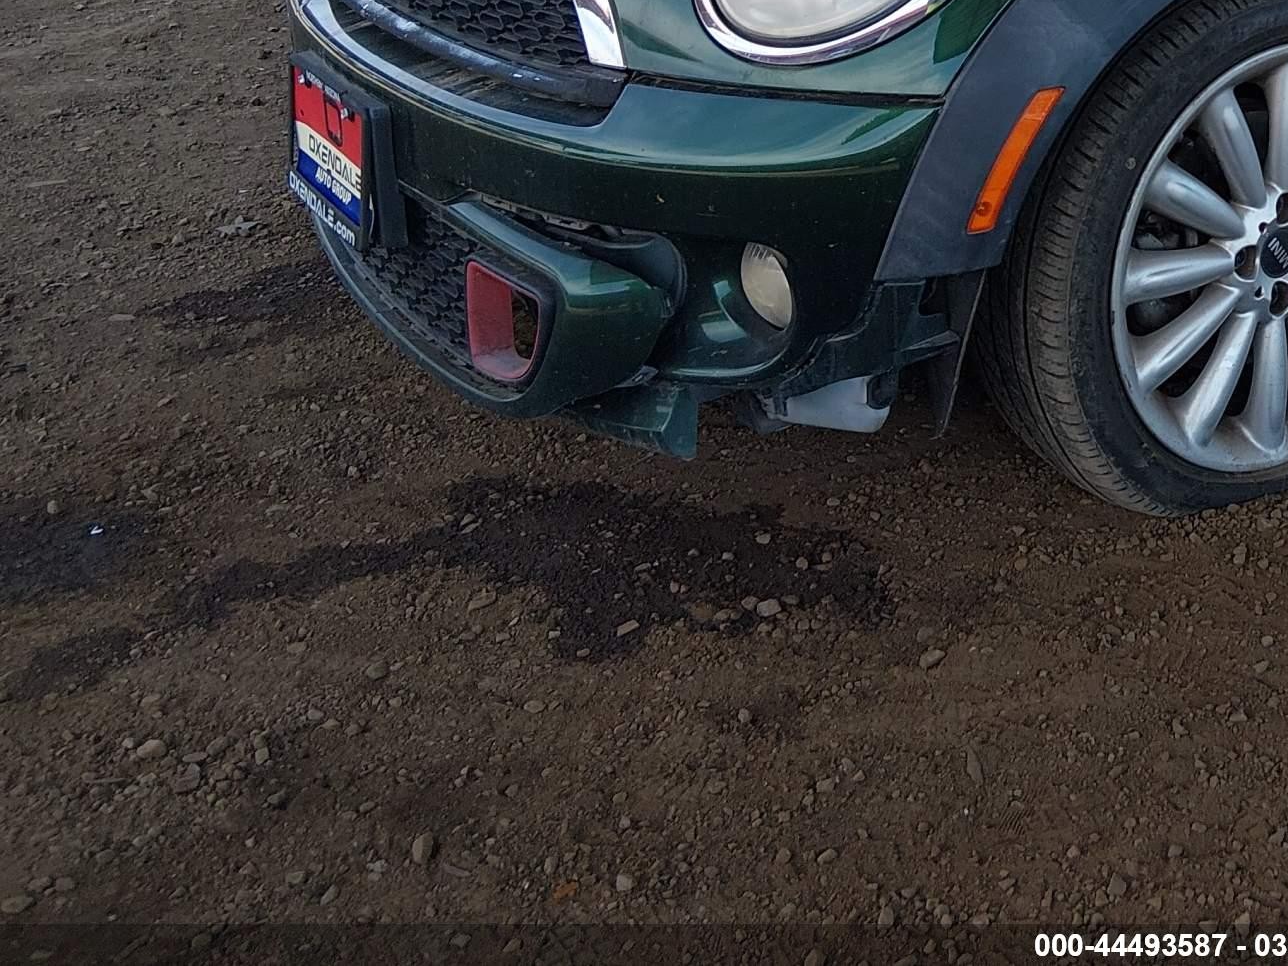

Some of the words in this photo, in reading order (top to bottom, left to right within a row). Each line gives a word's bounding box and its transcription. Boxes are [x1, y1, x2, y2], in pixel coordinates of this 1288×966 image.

[308, 134, 362, 190] OXENDALE
[315, 167, 332, 189] AUTO
[331, 179, 353, 206] GROUP
[289, 170, 356, 246] OXENDALE.com
